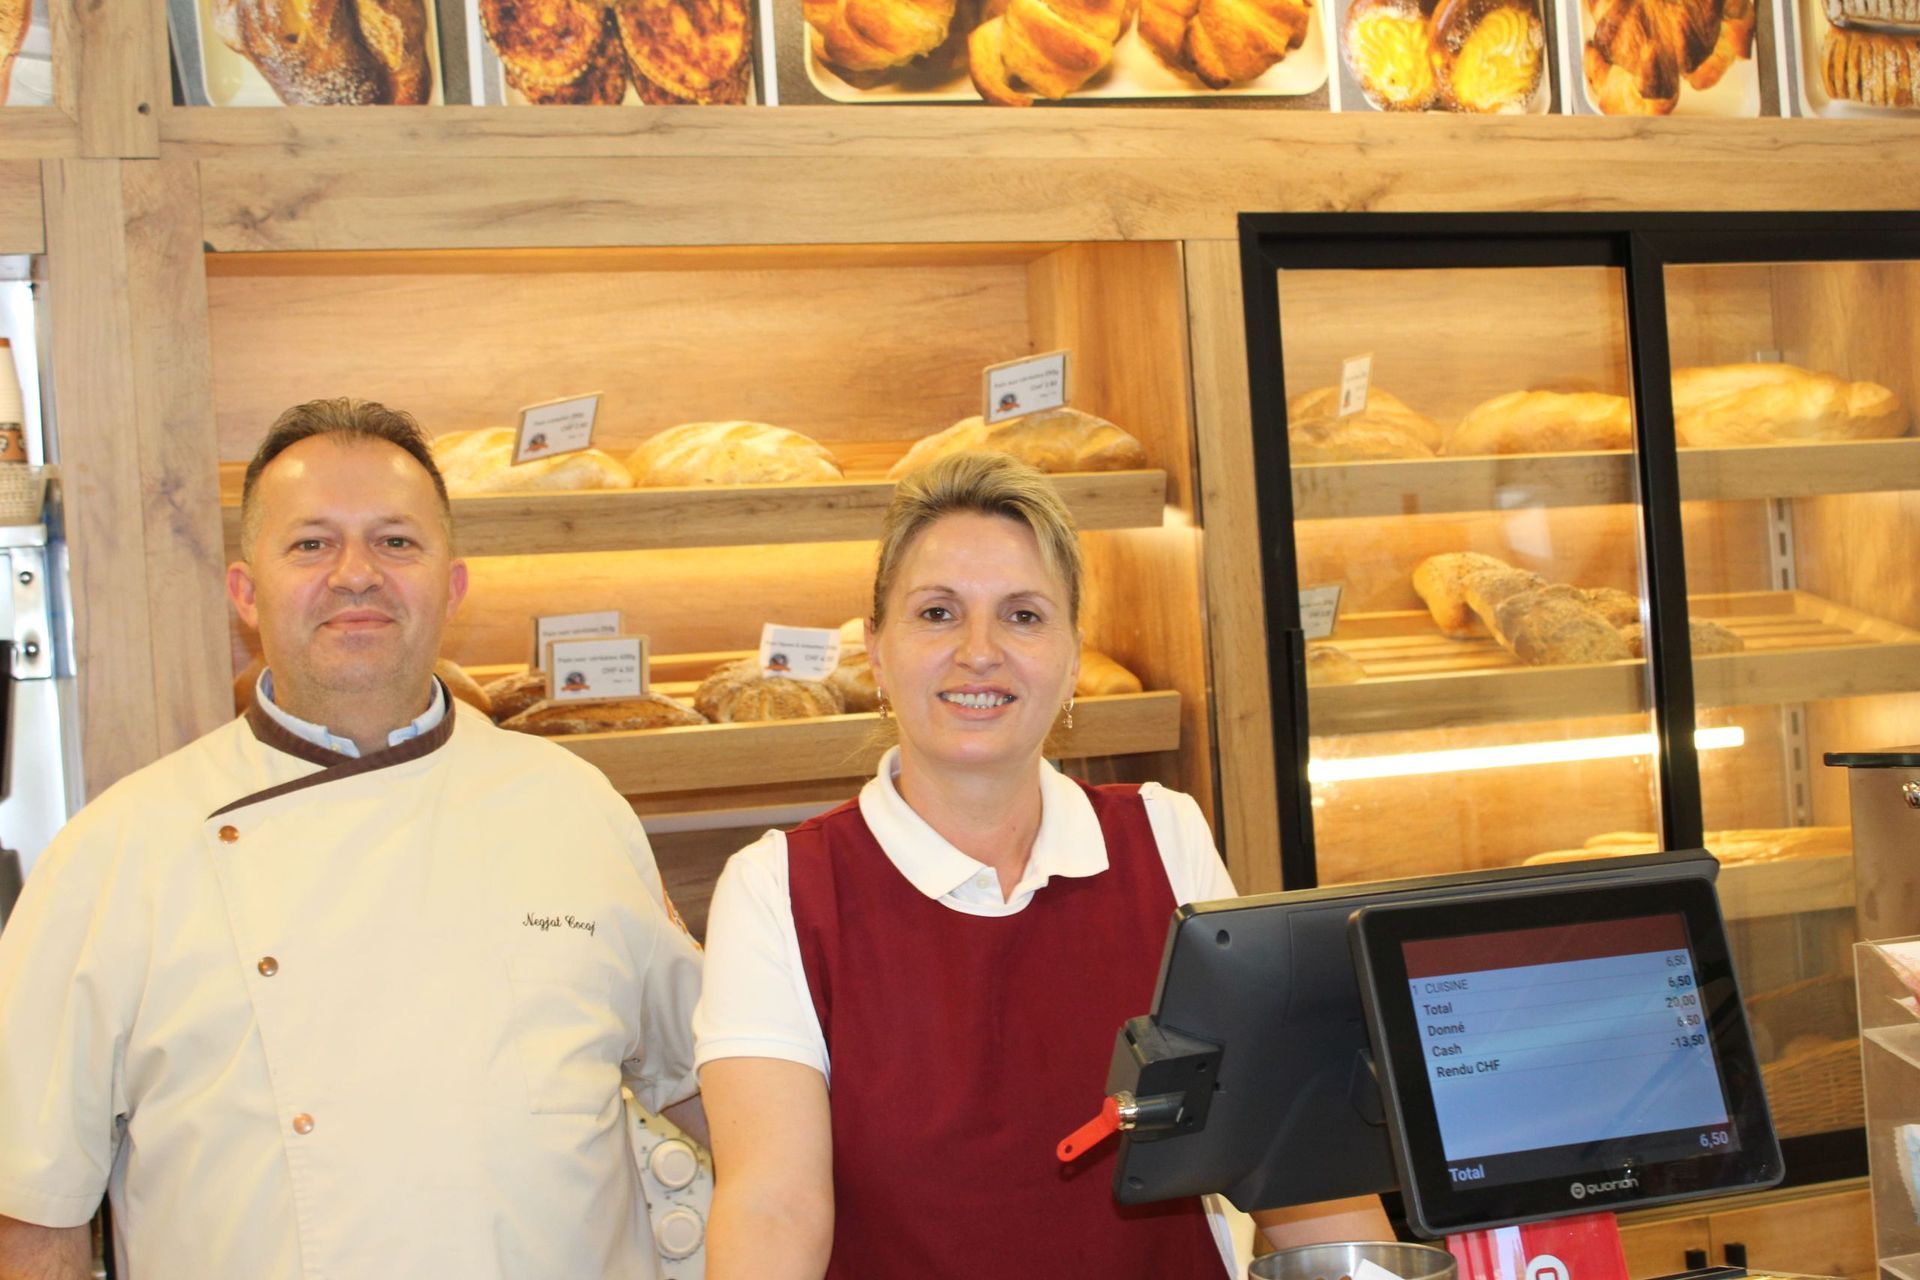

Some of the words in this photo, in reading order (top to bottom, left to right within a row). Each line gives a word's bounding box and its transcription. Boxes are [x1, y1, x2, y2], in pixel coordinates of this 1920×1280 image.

[1423, 1002, 1453, 1016] Total
[1668, 974, 1692, 989] 6,50
[1425, 979, 1469, 994] CUISINE
[1665, 954, 1688, 967] 6,50
[1427, 1021, 1466, 1037] Donné
[1432, 1043, 1462, 1057] Cash
[1677, 1014, 1701, 1028] 650
[1436, 1063, 1474, 1078] Rendu
[1476, 1059, 1501, 1073] CHF
[1670, 1033, 1705, 1049] -13,50
[1448, 1163, 1486, 1182] Total
[1700, 1130, 1729, 1149] 6,50
